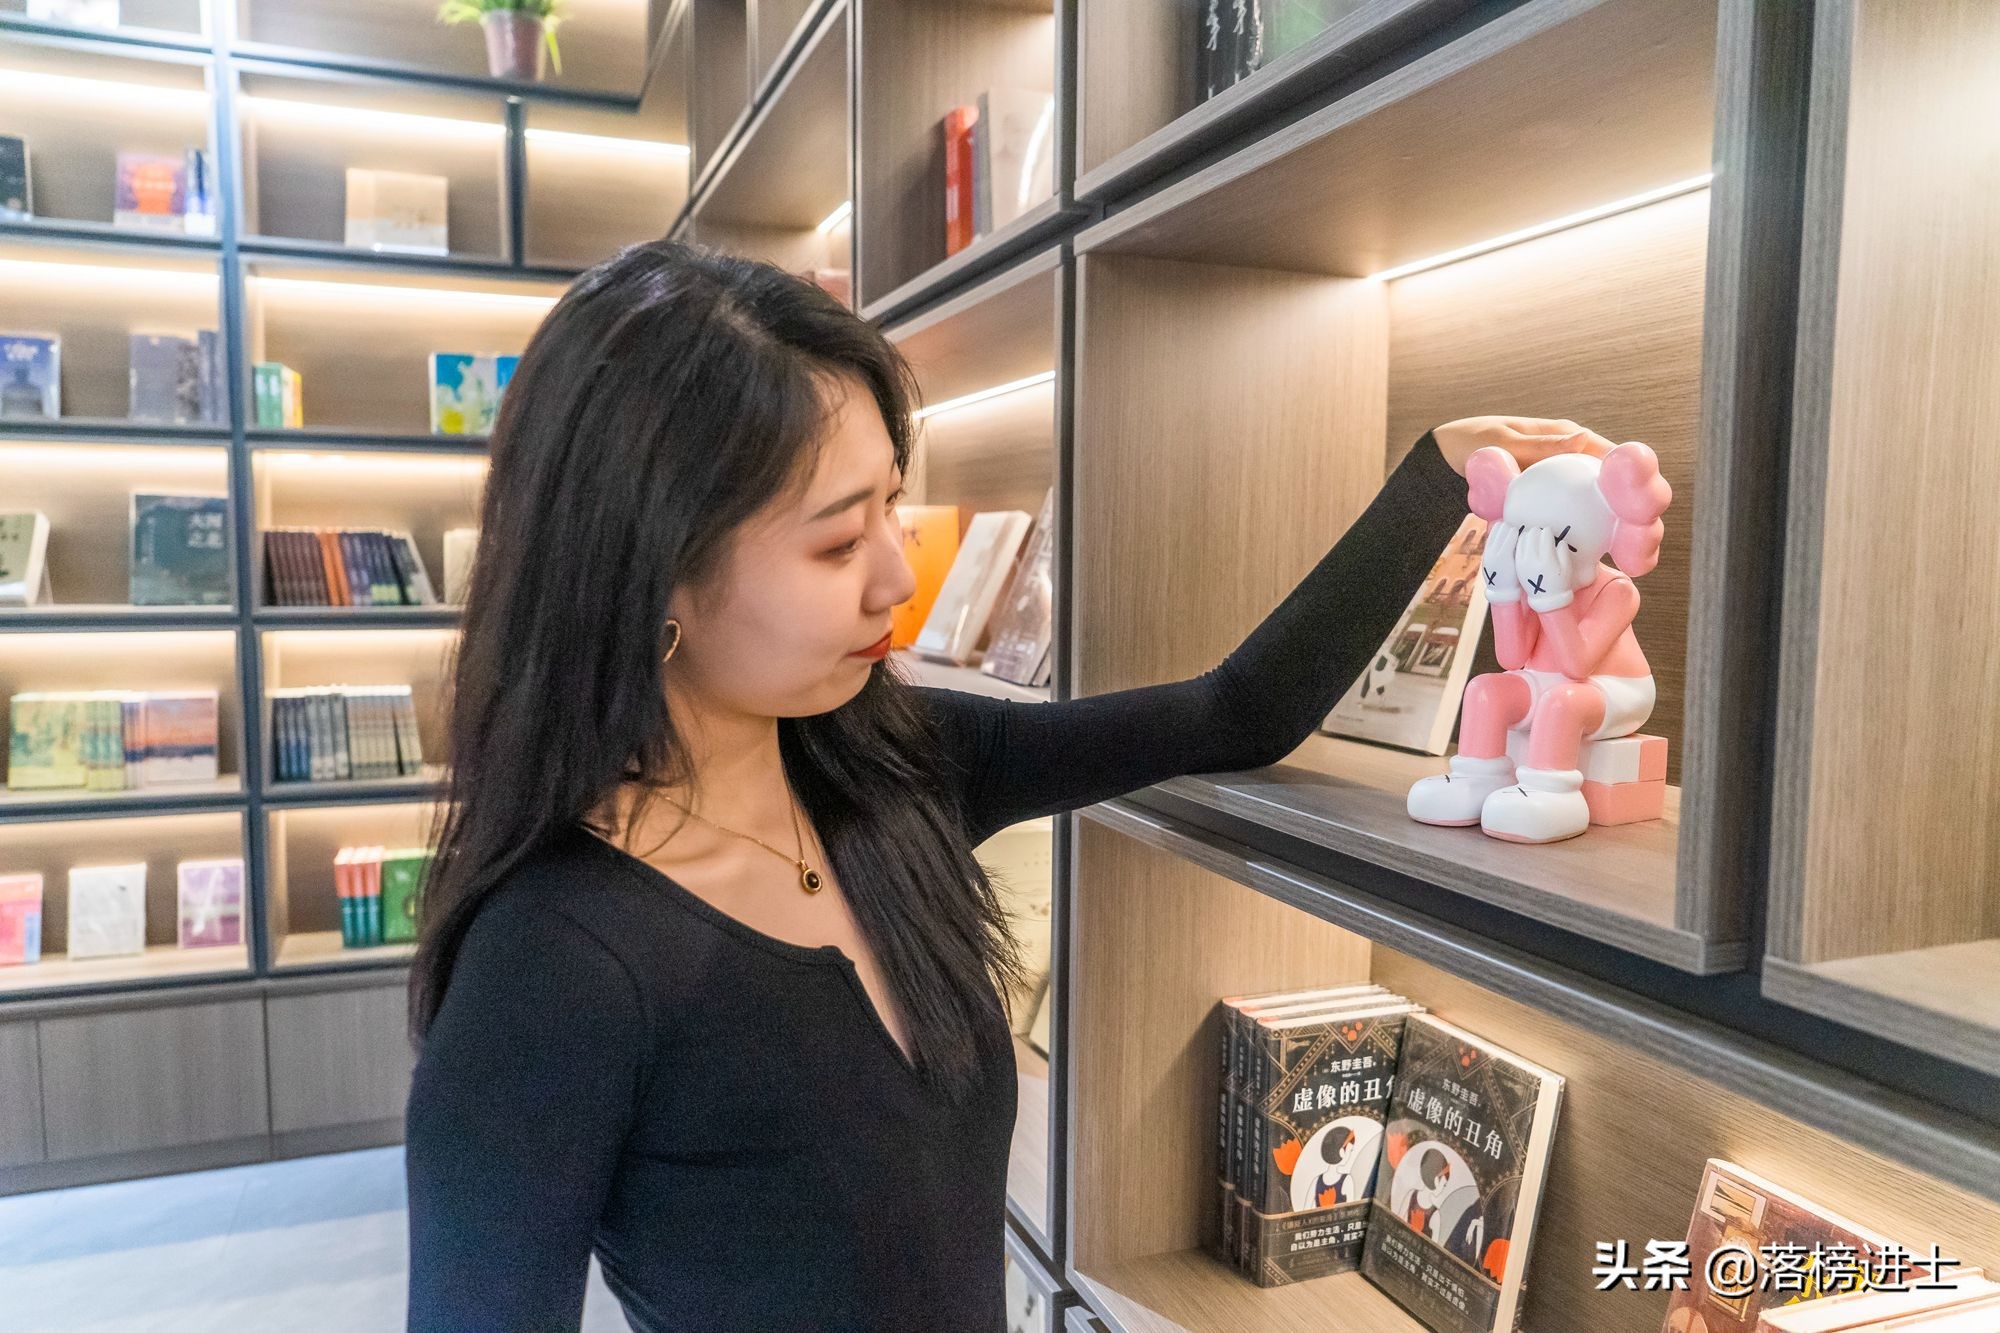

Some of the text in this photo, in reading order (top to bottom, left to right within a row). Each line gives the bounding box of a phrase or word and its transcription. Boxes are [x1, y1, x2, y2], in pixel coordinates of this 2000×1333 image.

[1330, 1056, 1374, 1073] 东野圭吾
[1407, 1087, 1503, 1160] 虚像的丑角
